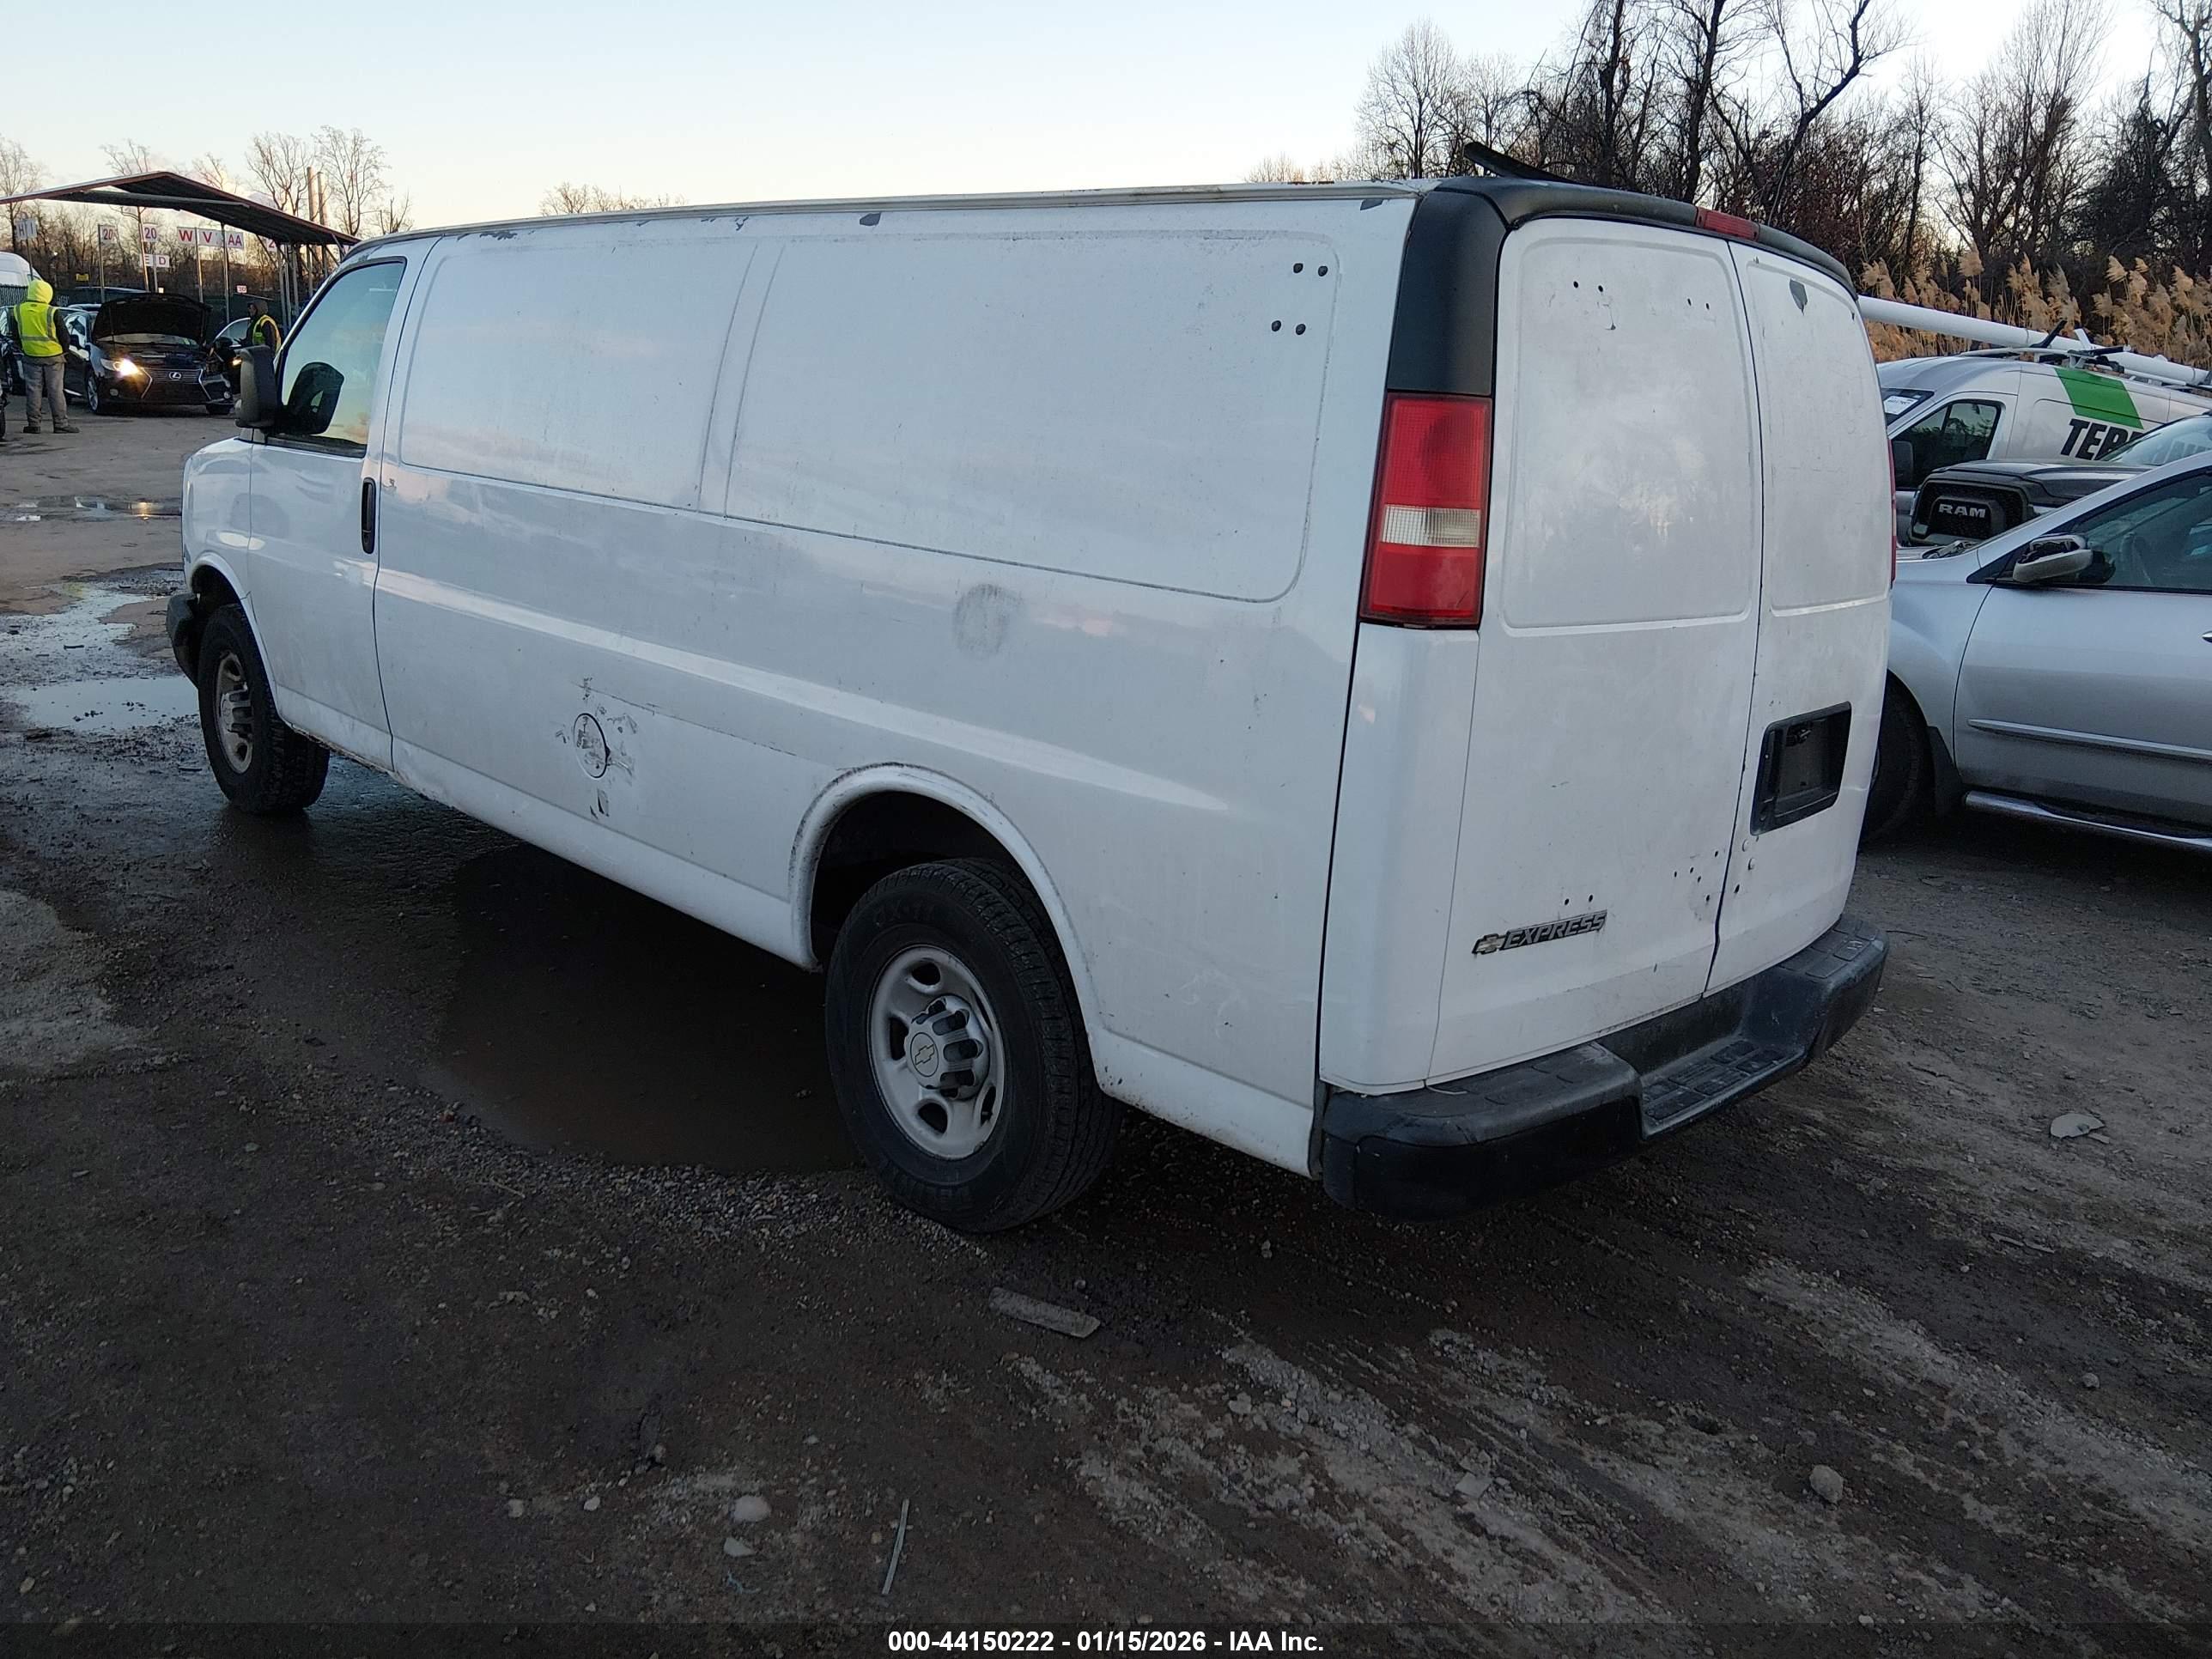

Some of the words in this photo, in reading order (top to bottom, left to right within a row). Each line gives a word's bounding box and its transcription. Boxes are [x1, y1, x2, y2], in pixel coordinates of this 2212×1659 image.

[103, 228, 113, 240] 20
[144, 227, 157, 240] 20
[179, 230, 193, 241] W
[203, 232, 213, 243] V
[228, 234, 242, 246] AA
[158, 256, 167, 265] D
[1938, 503, 1986, 519] RAM
[1503, 912, 1607, 950] EXPRESS
